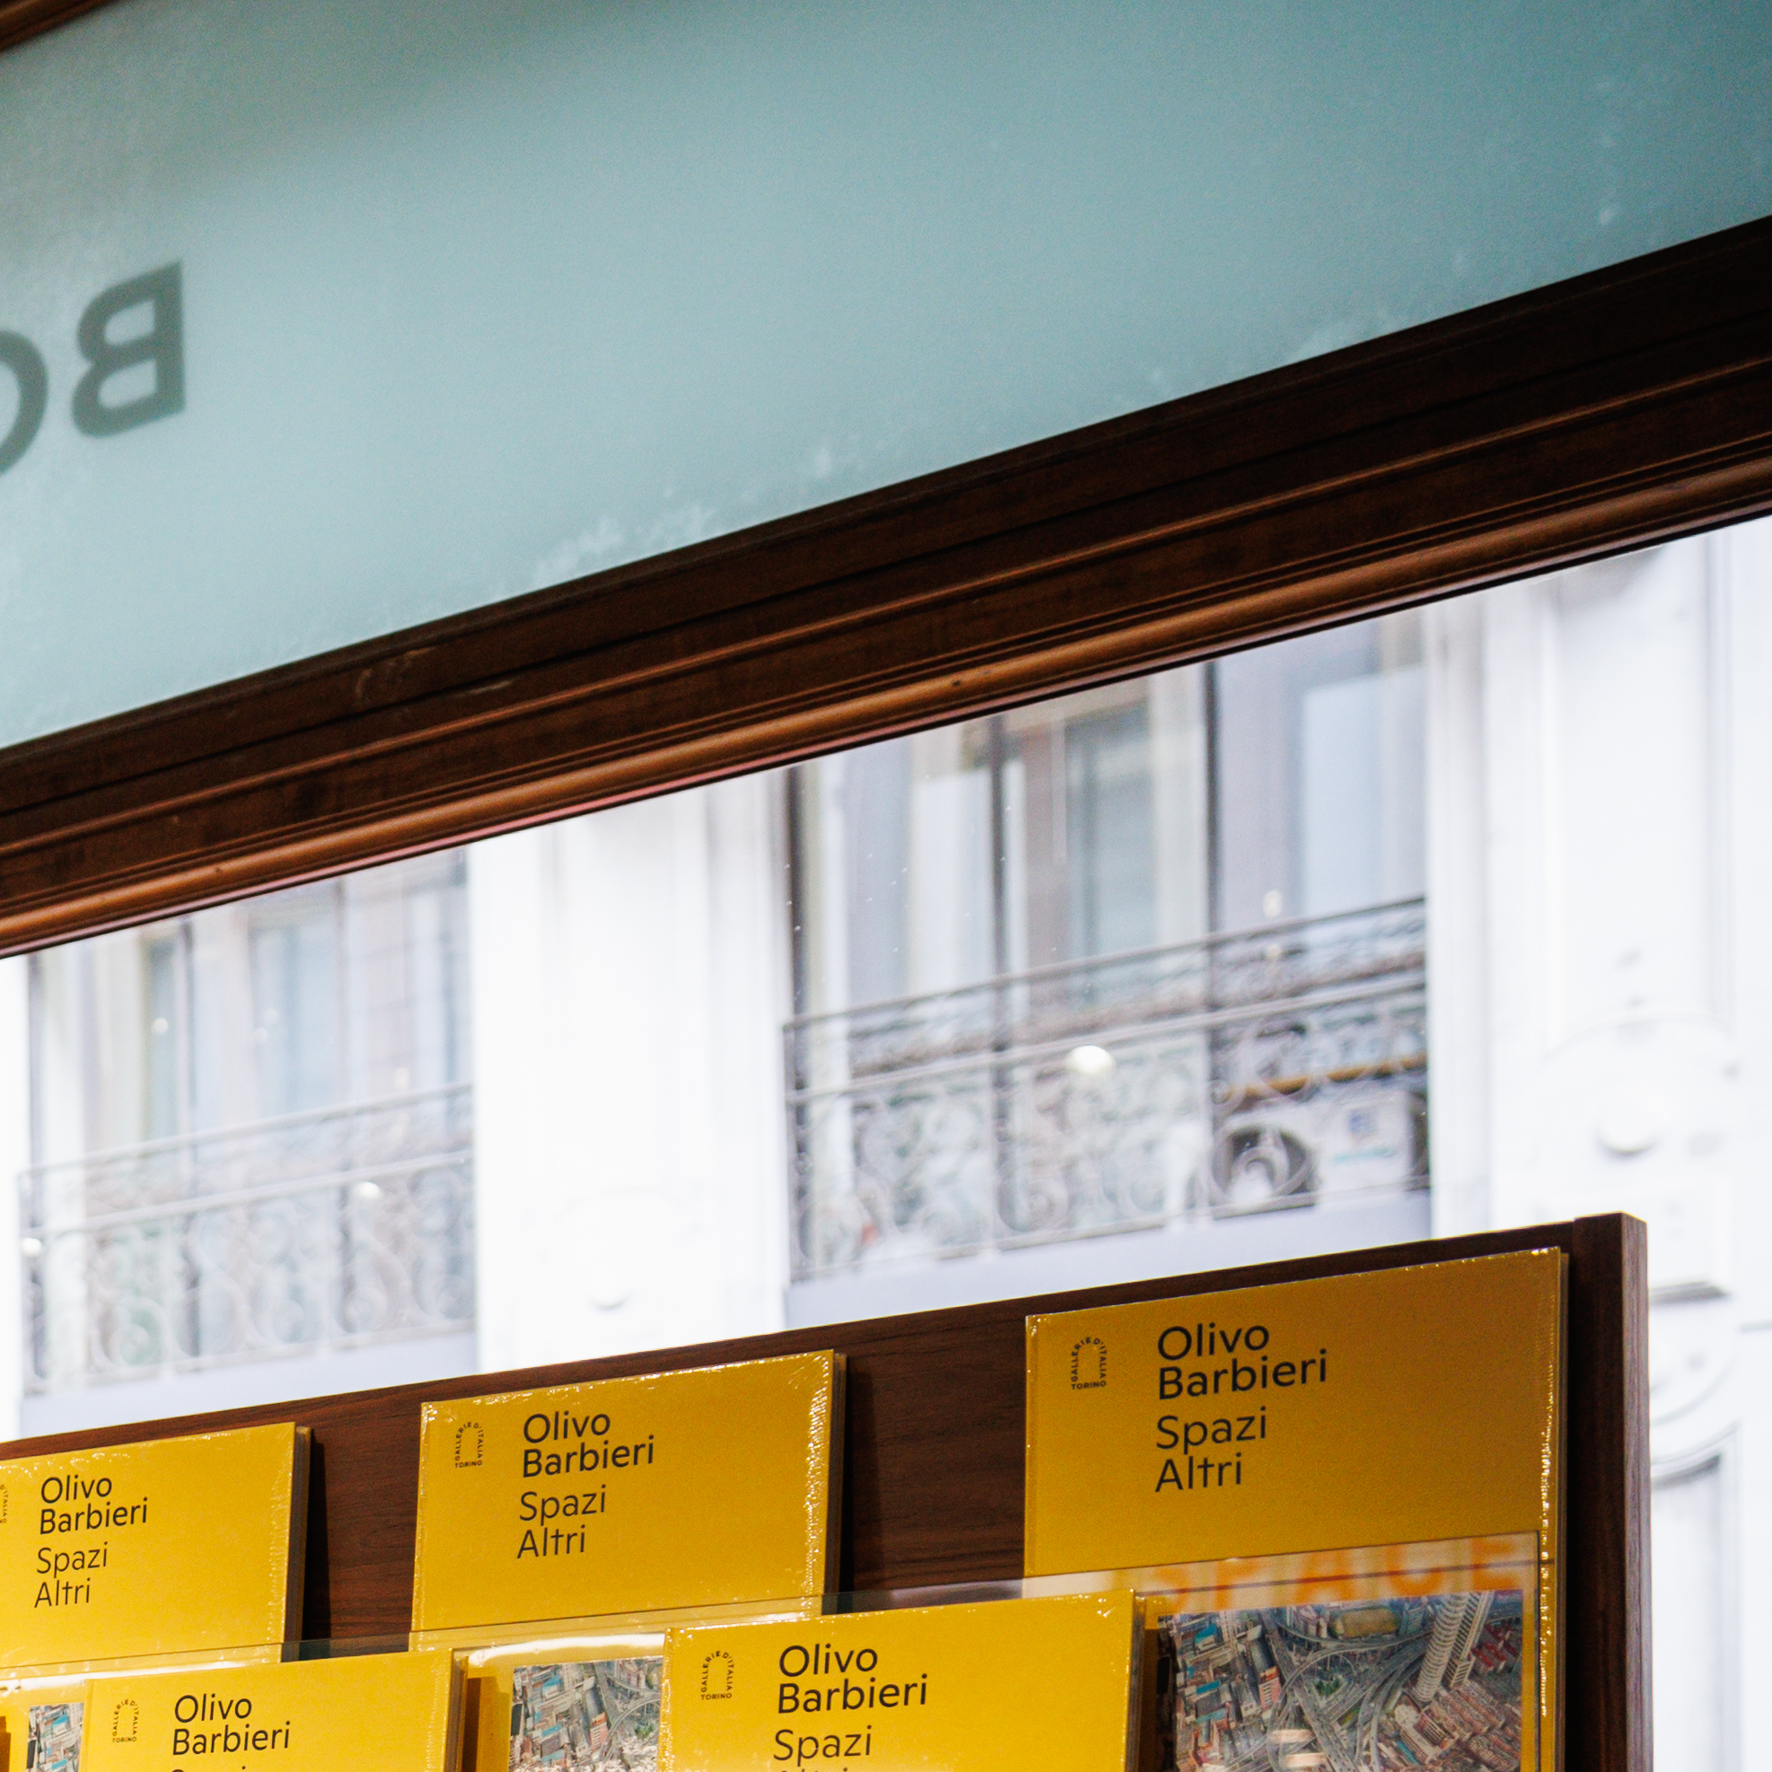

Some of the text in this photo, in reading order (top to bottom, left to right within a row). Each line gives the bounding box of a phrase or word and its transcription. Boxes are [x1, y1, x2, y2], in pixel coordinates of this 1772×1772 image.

[1071, 1337, 1091, 1382] GALLERIE
[1157, 1321, 1270, 1362] Olivo
[1071, 1380, 1106, 1390] TORINO
[1158, 1348, 1327, 1401] Barbieri
[455, 1422, 471, 1461] GALLERIE
[523, 1410, 611, 1446] Olivo
[1156, 1405, 1267, 1456] Spazi
[455, 1460, 482, 1468] TORINO
[522, 1434, 655, 1479] Barbieri
[1154, 1451, 1242, 1493] Altri
[40, 1473, 113, 1504] Olivo
[519, 1483, 607, 1527] Spazi
[39, 1500, 147, 1535] Barbieri
[516, 1523, 586, 1560] Altri
[36, 1546, 108, 1579] Spazi
[33, 1579, 90, 1609] Altri
[701, 1651, 721, 1692] GALLERIE
[779, 1642, 879, 1678] Olivo
[174, 1692, 253, 1724] Olivo
[701, 1692, 732, 1700] TORINO
[777, 1673, 928, 1715] Barbieri
[172, 1720, 291, 1756] Barbieri
[773, 1724, 873, 1768] Spazi
